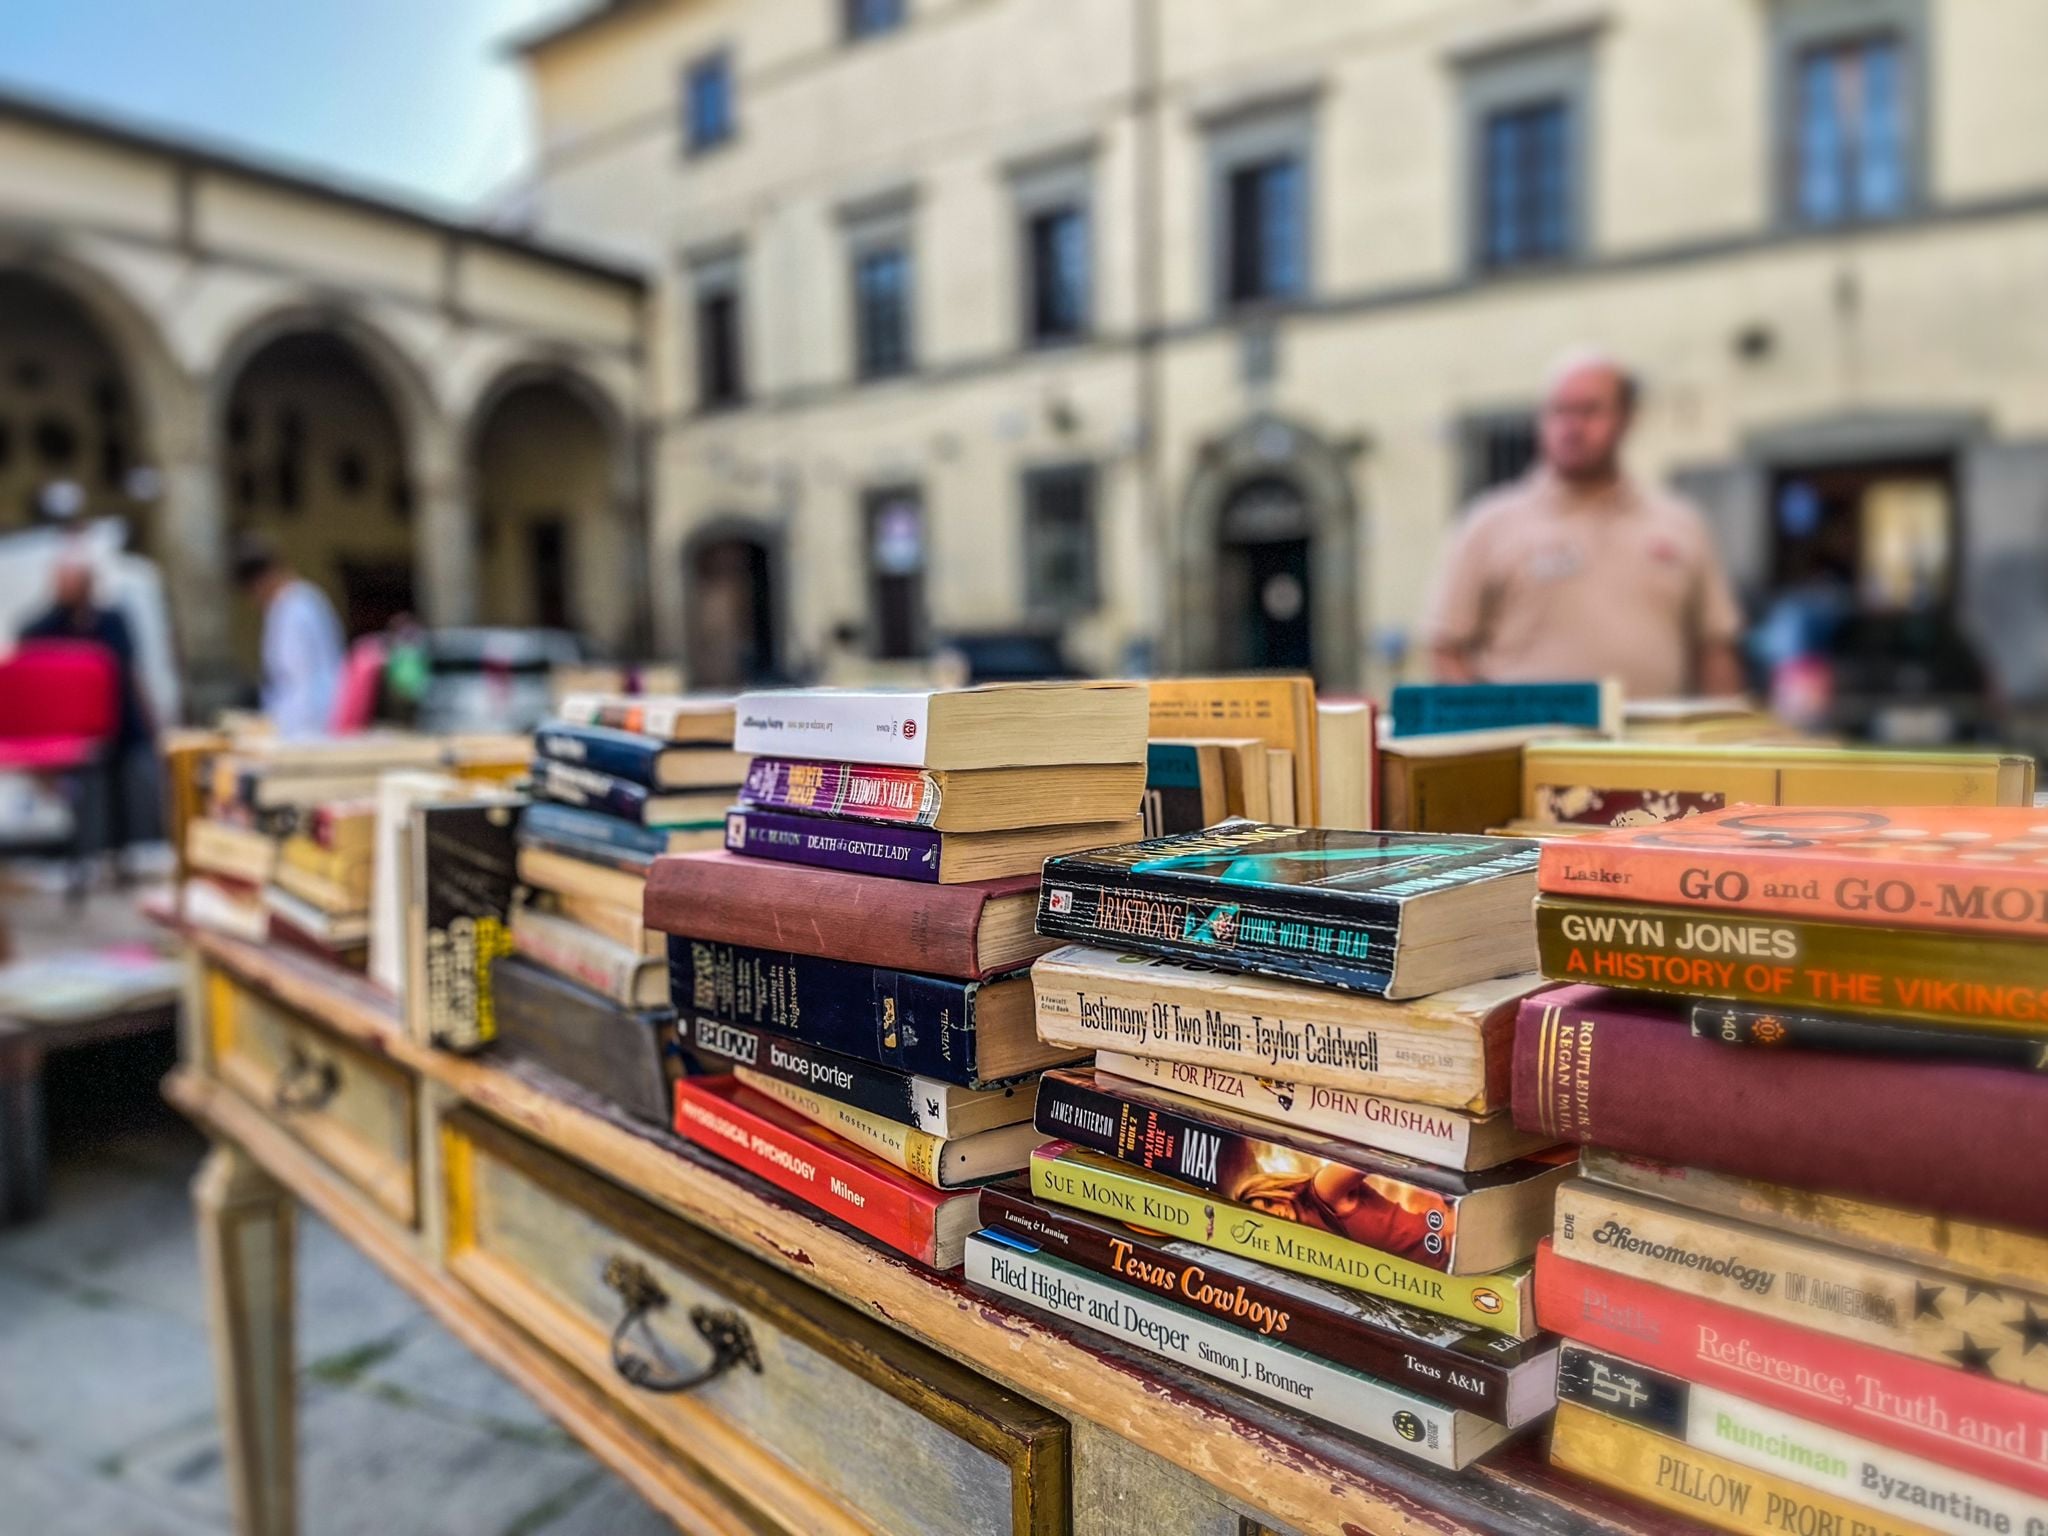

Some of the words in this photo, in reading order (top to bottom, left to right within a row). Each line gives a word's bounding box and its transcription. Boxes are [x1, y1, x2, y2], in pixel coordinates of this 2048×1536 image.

[807, 834, 837, 851] DEATH
[848, 840, 884, 858] GENTLE
[884, 845, 911, 861] LADY
[1563, 865, 1632, 886] Lasker
[1679, 867, 1750, 902] GO
[1762, 879, 1820, 902] and
[1093, 886, 1182, 941] ARMSTRONG
[1240, 916, 1276, 945] LIVING
[1280, 922, 1309, 950] WITH
[1312, 926, 1334, 954] THE
[1337, 930, 1369, 959] DEAD
[1561, 914, 1665, 948] GWYN
[1675, 922, 1798, 959] JONES
[788, 967, 800, 1029] Nightwork
[1566, 948, 1588, 975] A
[1593, 951, 1736, 988] HISTORY
[1745, 965, 1794, 996] OF
[1804, 969, 1882, 1005] THE
[941, 1008, 952, 1061] AVENEL
[1076, 991, 1148, 1044] Testimony
[1152, 1002, 1169, 1040] Of
[1171, 1004, 1201, 1045] Two
[1206, 1009, 1241, 1052] Men
[1252, 1015, 1300, 1066] Taylor
[1305, 1023, 1378, 1072] Caldwell
[1557, 1025, 1575, 1087] KEGAN
[770, 1043, 809, 1076] bruce
[811, 1062, 854, 1091] porter
[1576, 1020, 1595, 1126] ROUTLEDGE
[1050, 1100, 1073, 1124] JAMES
[1073, 1107, 1114, 1137] PATTERSON
[1129, 1117, 1138, 1126] 2
[1171, 1062, 1199, 1086] FOR
[1203, 1069, 1245, 1098] PIZZA
[1308, 1085, 1358, 1115] JOHN
[1364, 1100, 1453, 1139] GRISHAM
[839, 1111, 878, 1139] ROSETTA
[882, 1133, 901, 1151] LOY
[1126, 1127, 1137, 1151] BOOK
[1144, 1111, 1158, 1169] MAXIMUM
[1154, 1129, 1166, 1158] RIDE
[1165, 1135, 1175, 1158] NOVEL
[1181, 1127, 1221, 1184] MAX
[751, 1135, 817, 1182] PSYCHOLOGY
[830, 1176, 866, 1208] Milner
[1032, 1218, 1040, 1231] &
[1044, 1170, 1075, 1195] SUE
[1081, 1180, 1137, 1212] MONK
[1143, 1197, 1190, 1226] KIDD
[1275, 1235, 1370, 1278] MERMAID
[1374, 1263, 1445, 1301] CHAIR
[1563, 1213, 1576, 1240] EDIE
[1592, 1220, 1776, 1295] Phenomenology
[1784, 1271, 1806, 1304] IN
[1808, 1278, 1899, 1329] AMERICA
[991, 1256, 1027, 1292] Piled
[1031, 1270, 1085, 1313] Higher
[1088, 1298, 1120, 1327] and
[1123, 1304, 1190, 1353] Deeper
[1198, 1341, 1240, 1373] Simon
[1241, 1357, 1254, 1380] J.
[1255, 1362, 1314, 1401] Bronner
[1109, 1237, 1177, 1292] Texas
[1181, 1266, 1291, 1335] Cowboys
[1404, 1353, 1442, 1379] Texas
[1447, 1370, 1486, 1397] A&M
[1696, 1323, 1853, 1406] Reference,
[1855, 1373, 1949, 1432] Truth
[1958, 1416, 2027, 1455] and
[1655, 1454, 1753, 1517] PILLOW
[1763, 1491, 1906, 1536] PROBL
[1715, 1412, 1849, 1479] Runciman
[1861, 1461, 2011, 1535] Byzantine
